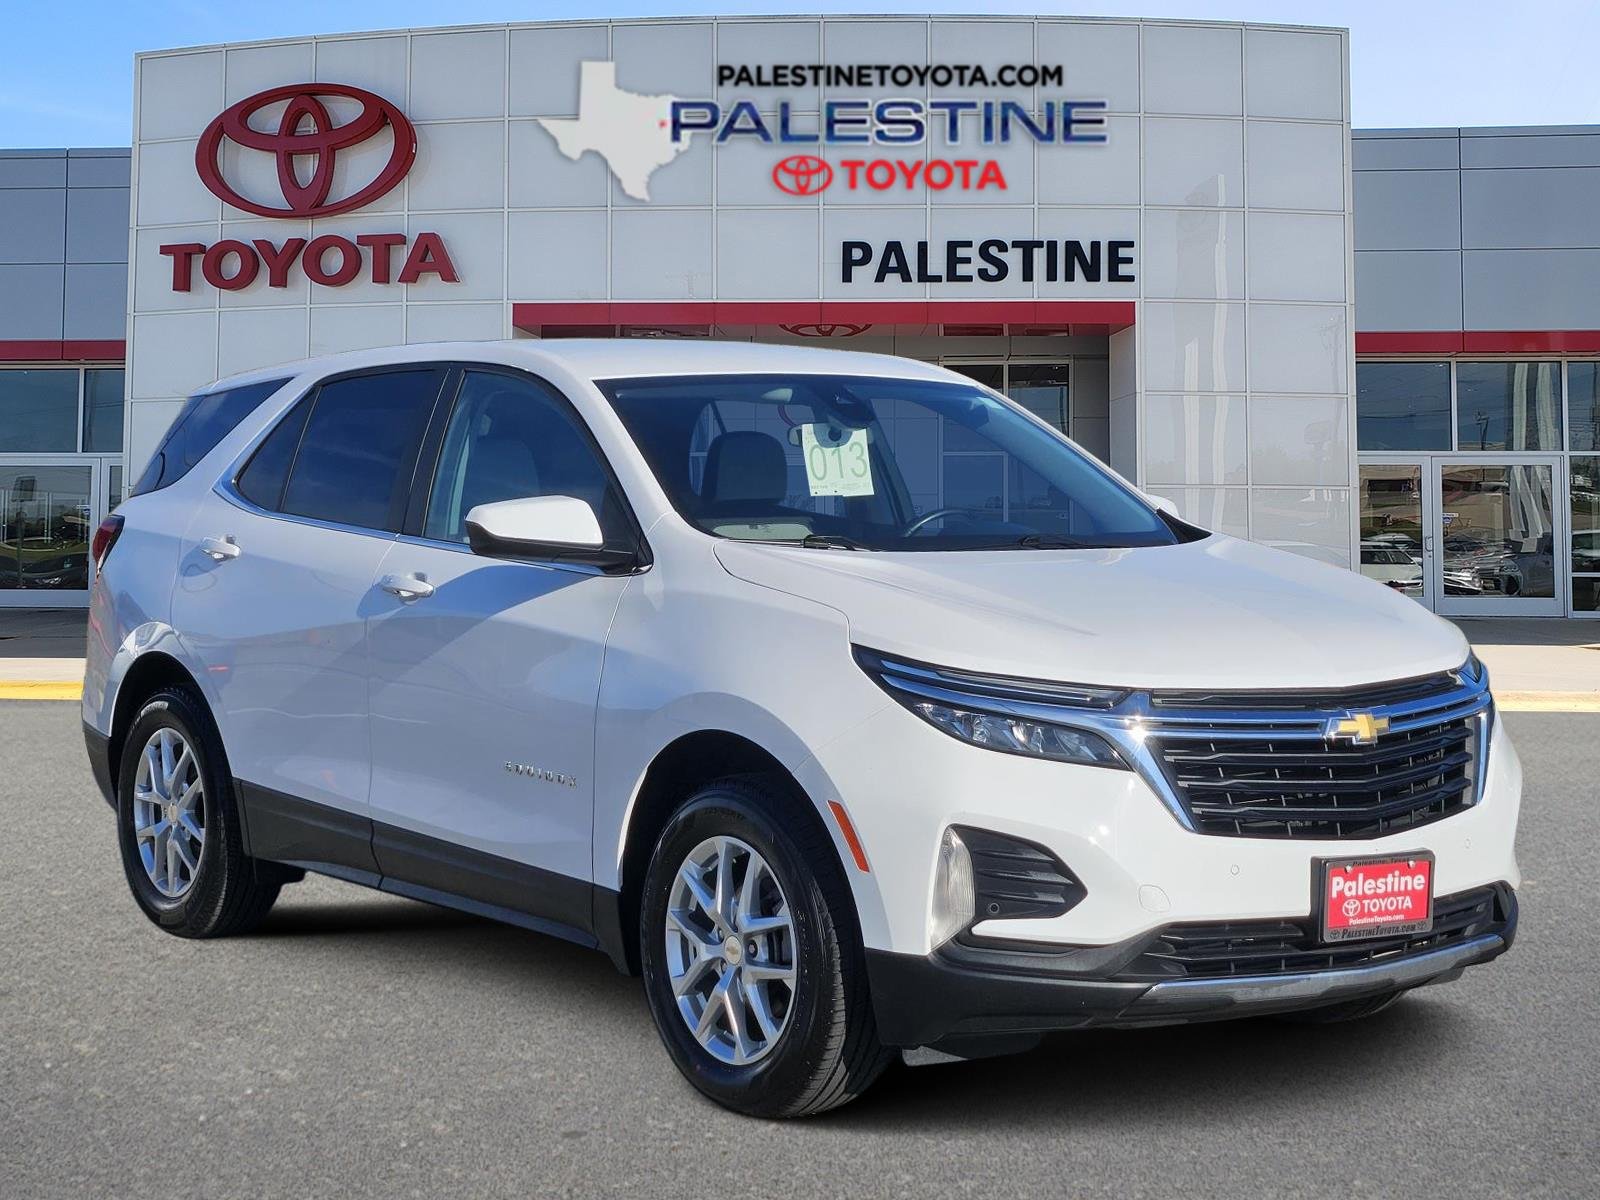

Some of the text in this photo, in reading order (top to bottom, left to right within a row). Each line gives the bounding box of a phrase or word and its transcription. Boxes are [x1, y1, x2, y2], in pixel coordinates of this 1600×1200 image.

[159, 232, 461, 292] TOYOTA
[841, 239, 1136, 283] PALESTINE
[809, 441, 868, 481] 013
[1331, 870, 1425, 898] Palestine
[1362, 896, 1412, 913] TOYOTA
